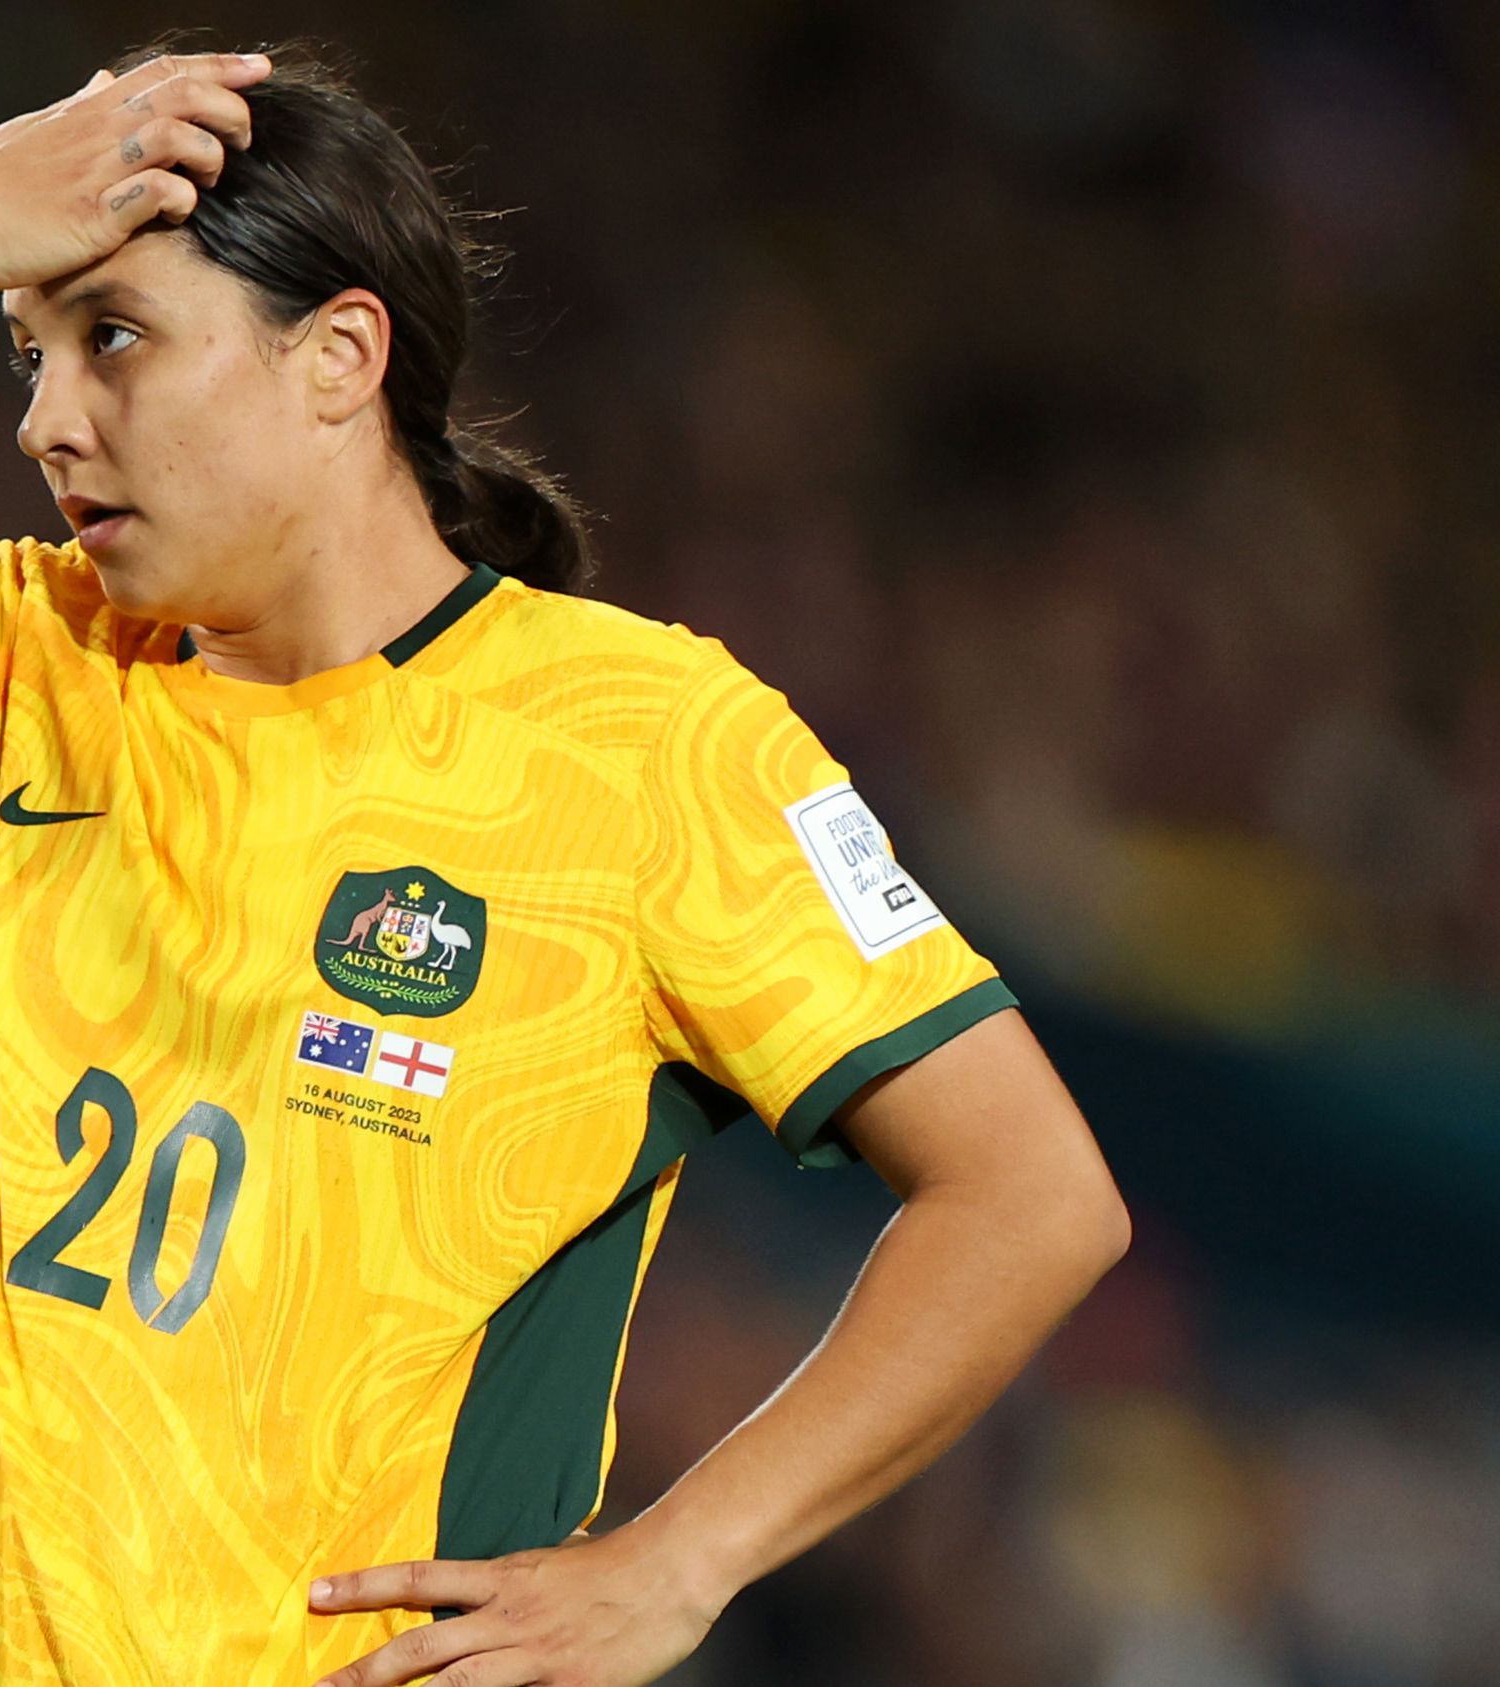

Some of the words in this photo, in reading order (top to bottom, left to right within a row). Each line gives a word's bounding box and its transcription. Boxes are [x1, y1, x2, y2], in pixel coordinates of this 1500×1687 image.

[826, 808, 872, 841] FOOT
[837, 830, 884, 868] UNI
[850, 868, 880, 895] the
[341, 951, 448, 986] AUSTRALIA
[285, 1097, 345, 1126] SYDNEY,
[350, 1115, 432, 1146] AUSTRALIA
[304, 1083, 320, 1097] 16
[322, 1088, 385, 1114] AUGUST
[387, 1105, 421, 1124] 2023
[6, 1066, 246, 1335] 20
